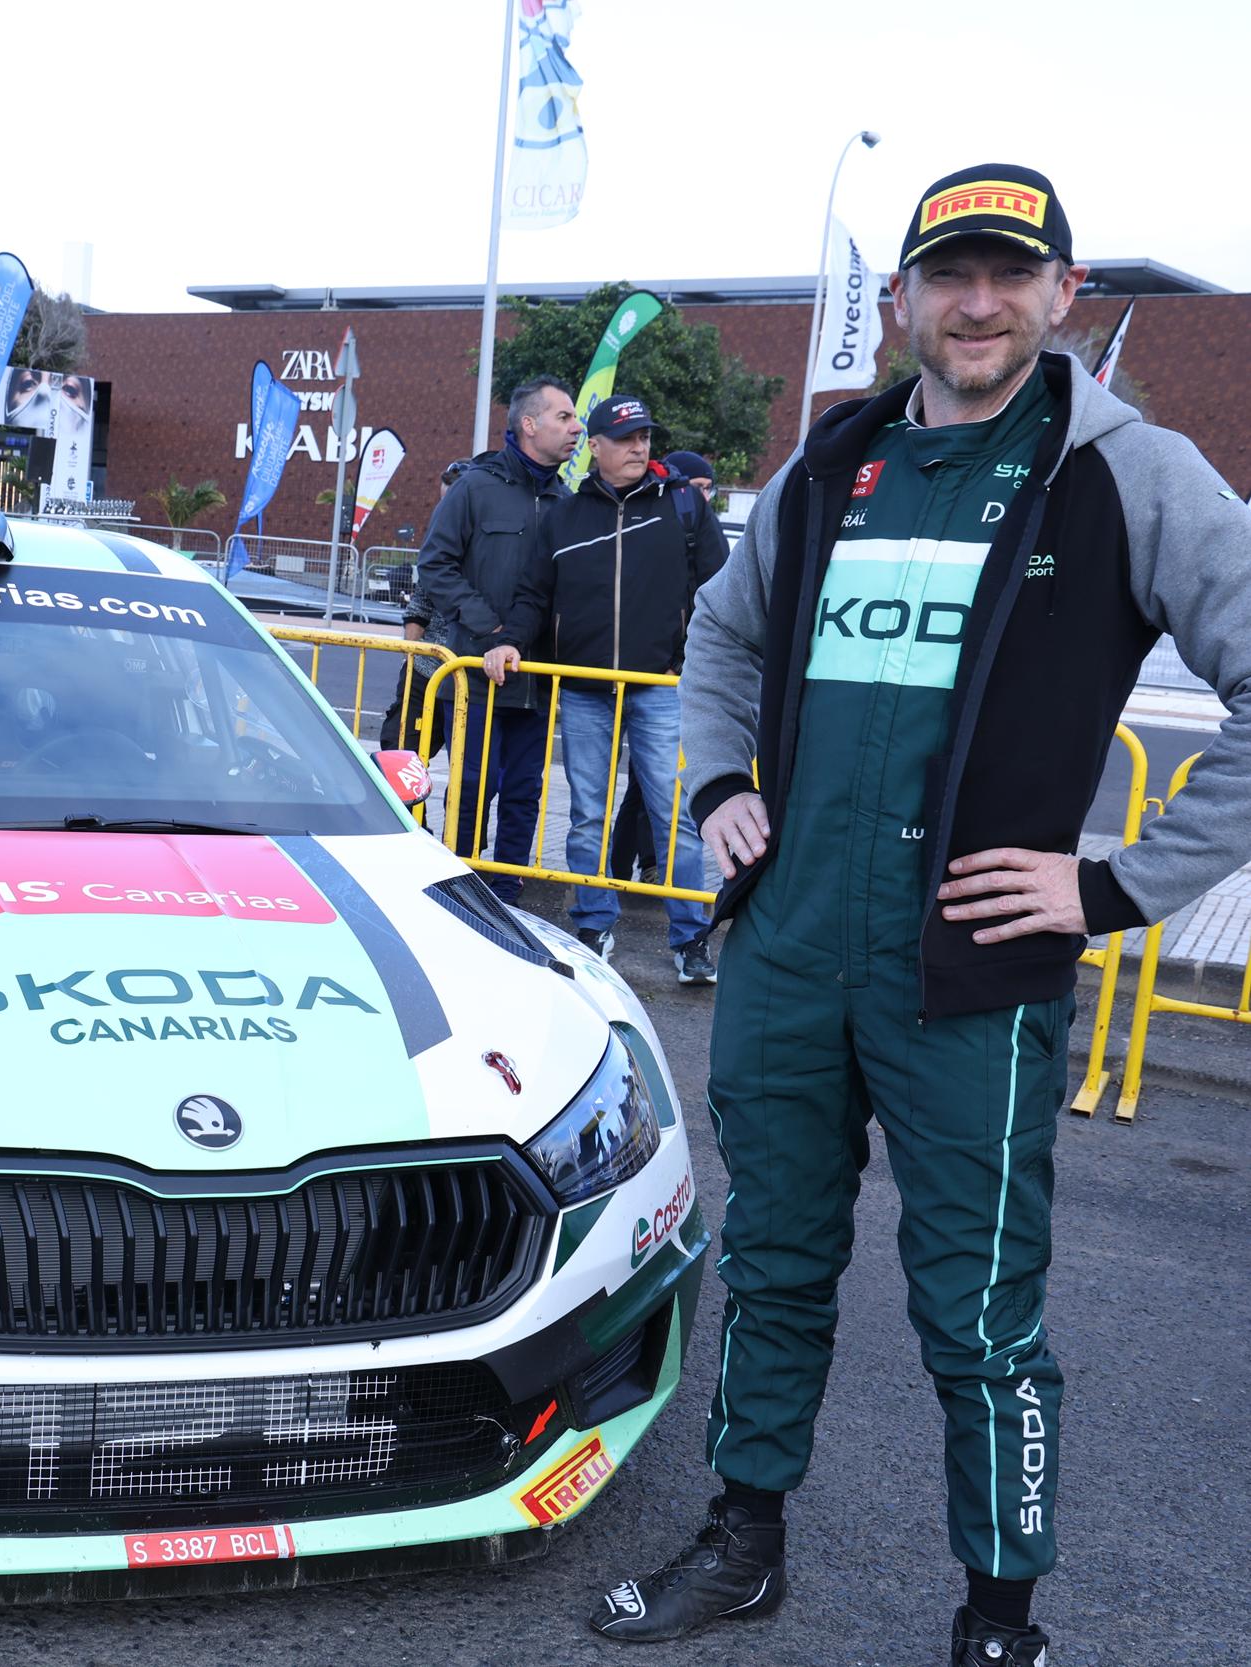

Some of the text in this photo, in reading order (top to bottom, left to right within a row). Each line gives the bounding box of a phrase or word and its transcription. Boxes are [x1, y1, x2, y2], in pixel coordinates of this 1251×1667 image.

[512, 183, 582, 208] CICAR
[926, 186, 1039, 225] PIRELLI
[0, 280, 16, 307] DEL
[280, 350, 337, 380] ZARA
[293, 391, 335, 411] YSK
[50, 408, 58, 439] Orvec
[235, 423, 373, 462] KABI
[269, 438, 290, 488] DEPORTE
[841, 513, 866, 528] RAL
[818, 597, 972, 645] KOD
[901, 827, 925, 840] LU
[81, 882, 300, 912] Canarias
[49, 1015, 298, 1043] CANARIAS
[653, 1161, 692, 1244] Castrol
[1015, 1377, 1046, 1535] SKODA
[519, 1437, 614, 1527] PIRELLI
[132, 1541, 149, 1564] S
[159, 1536, 217, 1562] 3387
[229, 1533, 277, 1557] BCL
